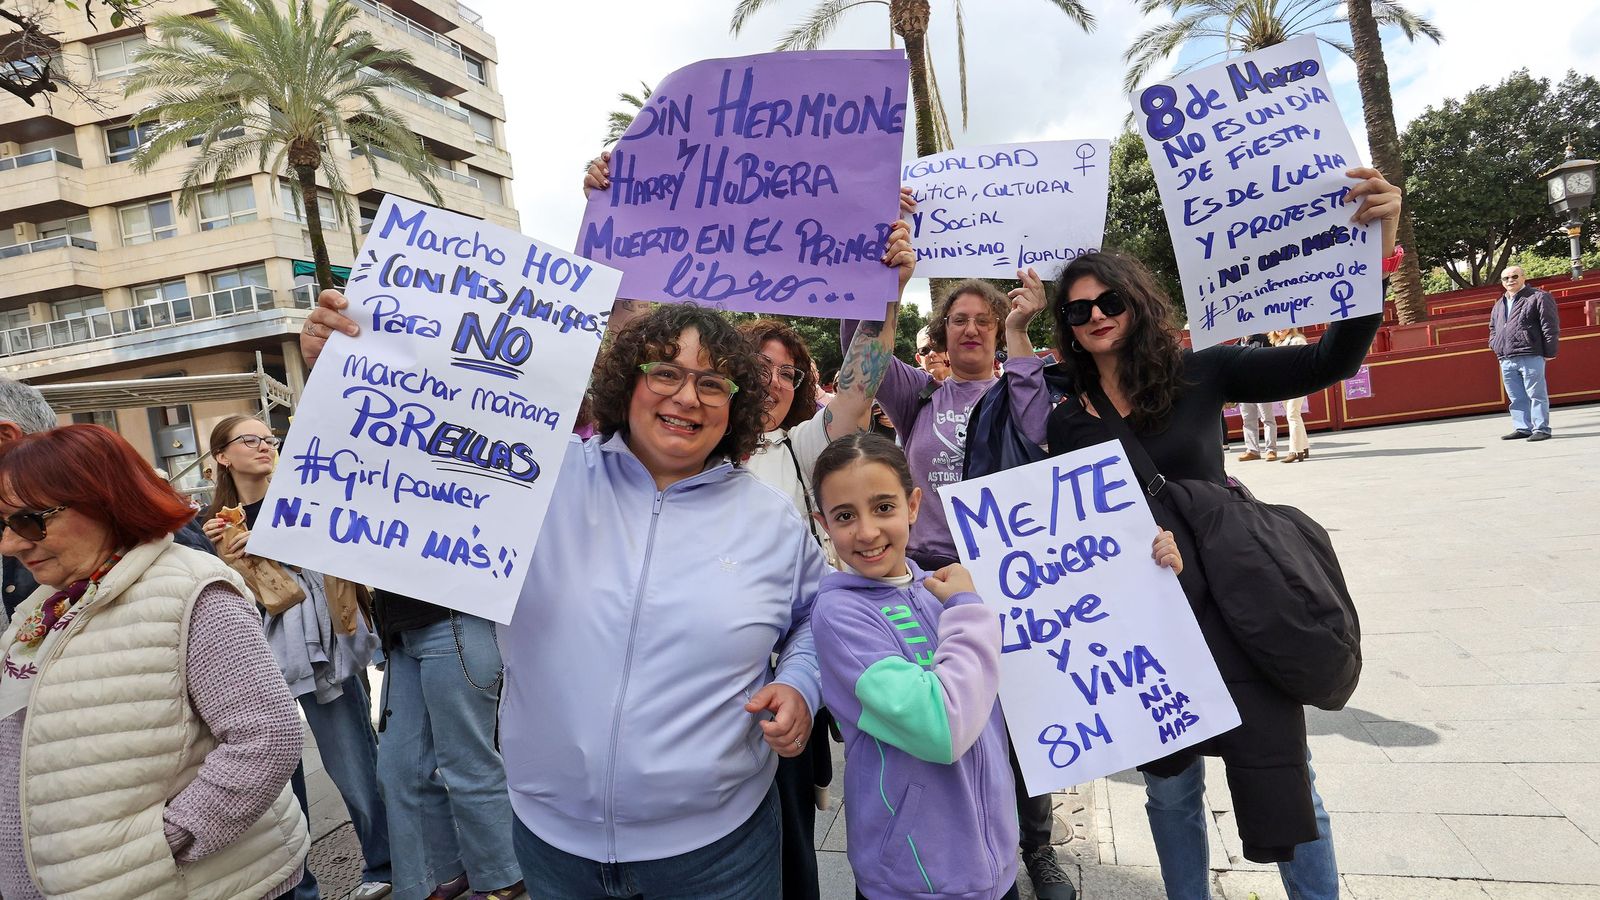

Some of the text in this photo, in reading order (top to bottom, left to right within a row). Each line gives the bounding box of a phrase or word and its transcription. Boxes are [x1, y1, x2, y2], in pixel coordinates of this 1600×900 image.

[1140, 59, 1320, 141] 8 de Marzo
[1162, 132, 1206, 168] NO
[1212, 118, 1246, 142] ES
[1245, 103, 1285, 125] UN
[902, 149, 1038, 181] IGUALDAD
[1177, 160, 1214, 190] DE
[983, 180, 1074, 198] CULTURAL
[1184, 153, 1347, 226] ES DE LUCHA
[379, 203, 593, 293] Marcho HOY
[583, 216, 690, 260] MUERTO
[696, 224, 735, 255] EN
[744, 217, 784, 256] EL
[1196, 232, 1214, 259] Y
[1257, 244, 1300, 271] UNA
[379, 253, 446, 294] CON
[1348, 260, 1368, 276] de
[362, 295, 534, 367] Para NO
[1237, 308, 1255, 322] la
[343, 354, 560, 430] marchar mañana
[329, 507, 409, 549] UNA
[999, 593, 1110, 653] Libre
[1151, 691, 1190, 722] UNA
[1037, 713, 1113, 768] 8M
[1159, 711, 1199, 744] MAS
